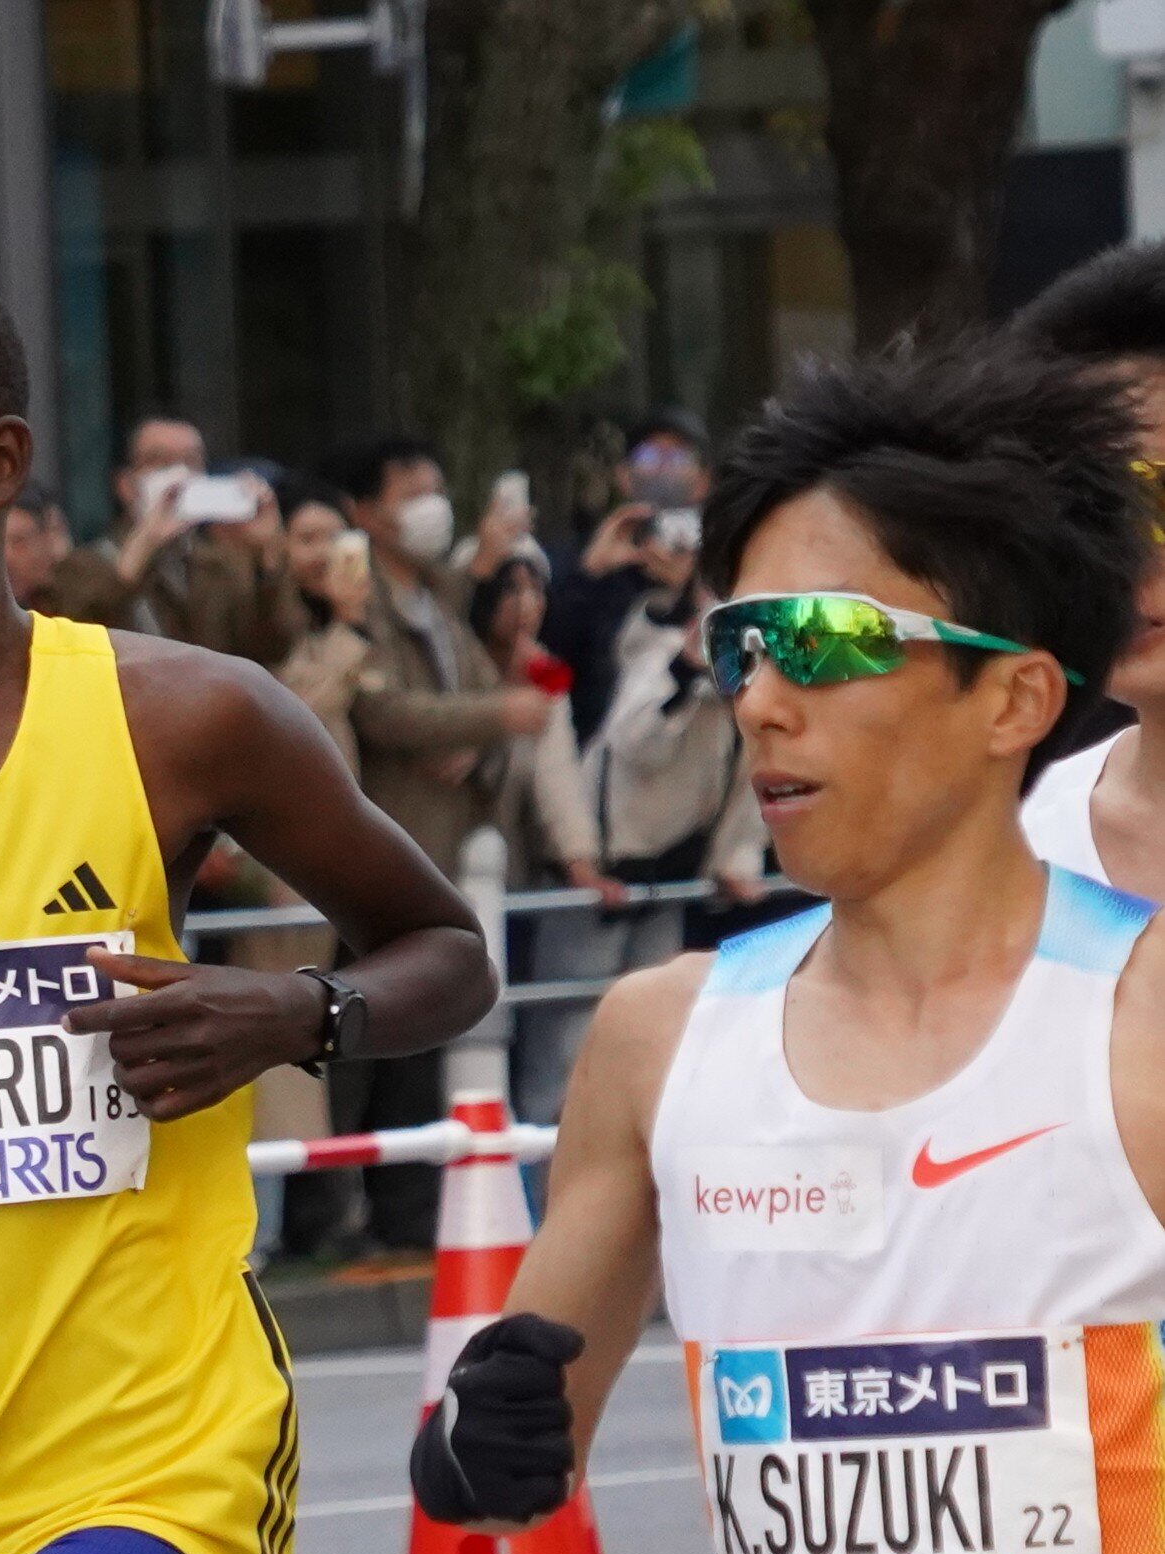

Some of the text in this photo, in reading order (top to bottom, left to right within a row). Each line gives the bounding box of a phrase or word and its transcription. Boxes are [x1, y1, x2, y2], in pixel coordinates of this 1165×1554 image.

[89, 1084, 140, 1122] 18
[694, 1173, 826, 1225] kewpie
[804, 1361, 1029, 1420] 東京メトロ
[1023, 1504, 1075, 1550] 22
